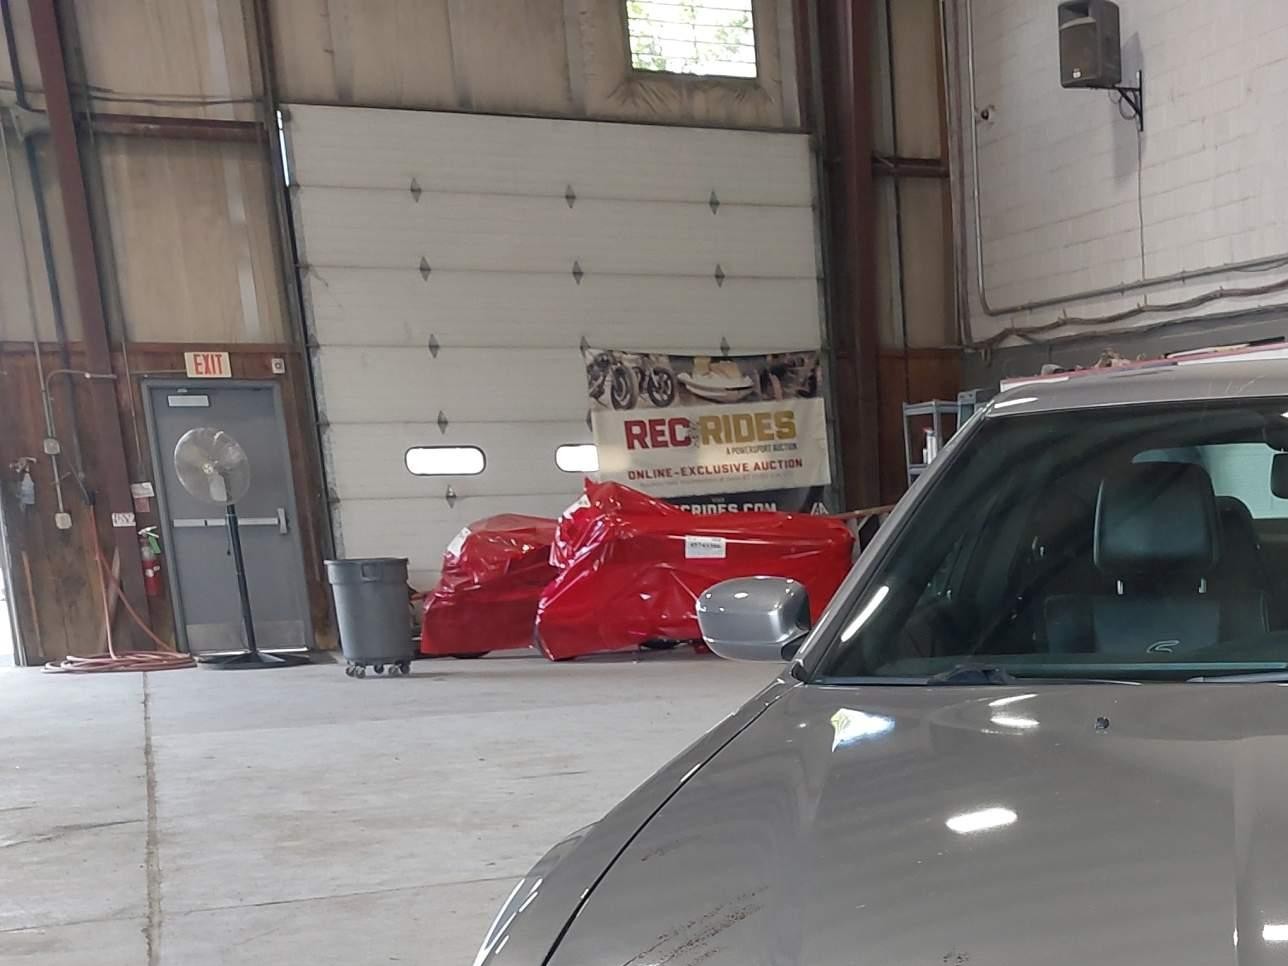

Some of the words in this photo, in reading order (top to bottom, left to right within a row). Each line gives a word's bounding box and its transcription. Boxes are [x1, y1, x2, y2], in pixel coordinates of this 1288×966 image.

[193, 354, 223, 375] EXIT
[624, 417, 692, 450] REC
[698, 410, 797, 446] RIDES
[628, 460, 750, 481] ONLINE-EXCLUSIVE
[753, 457, 803, 473] AUCTION
